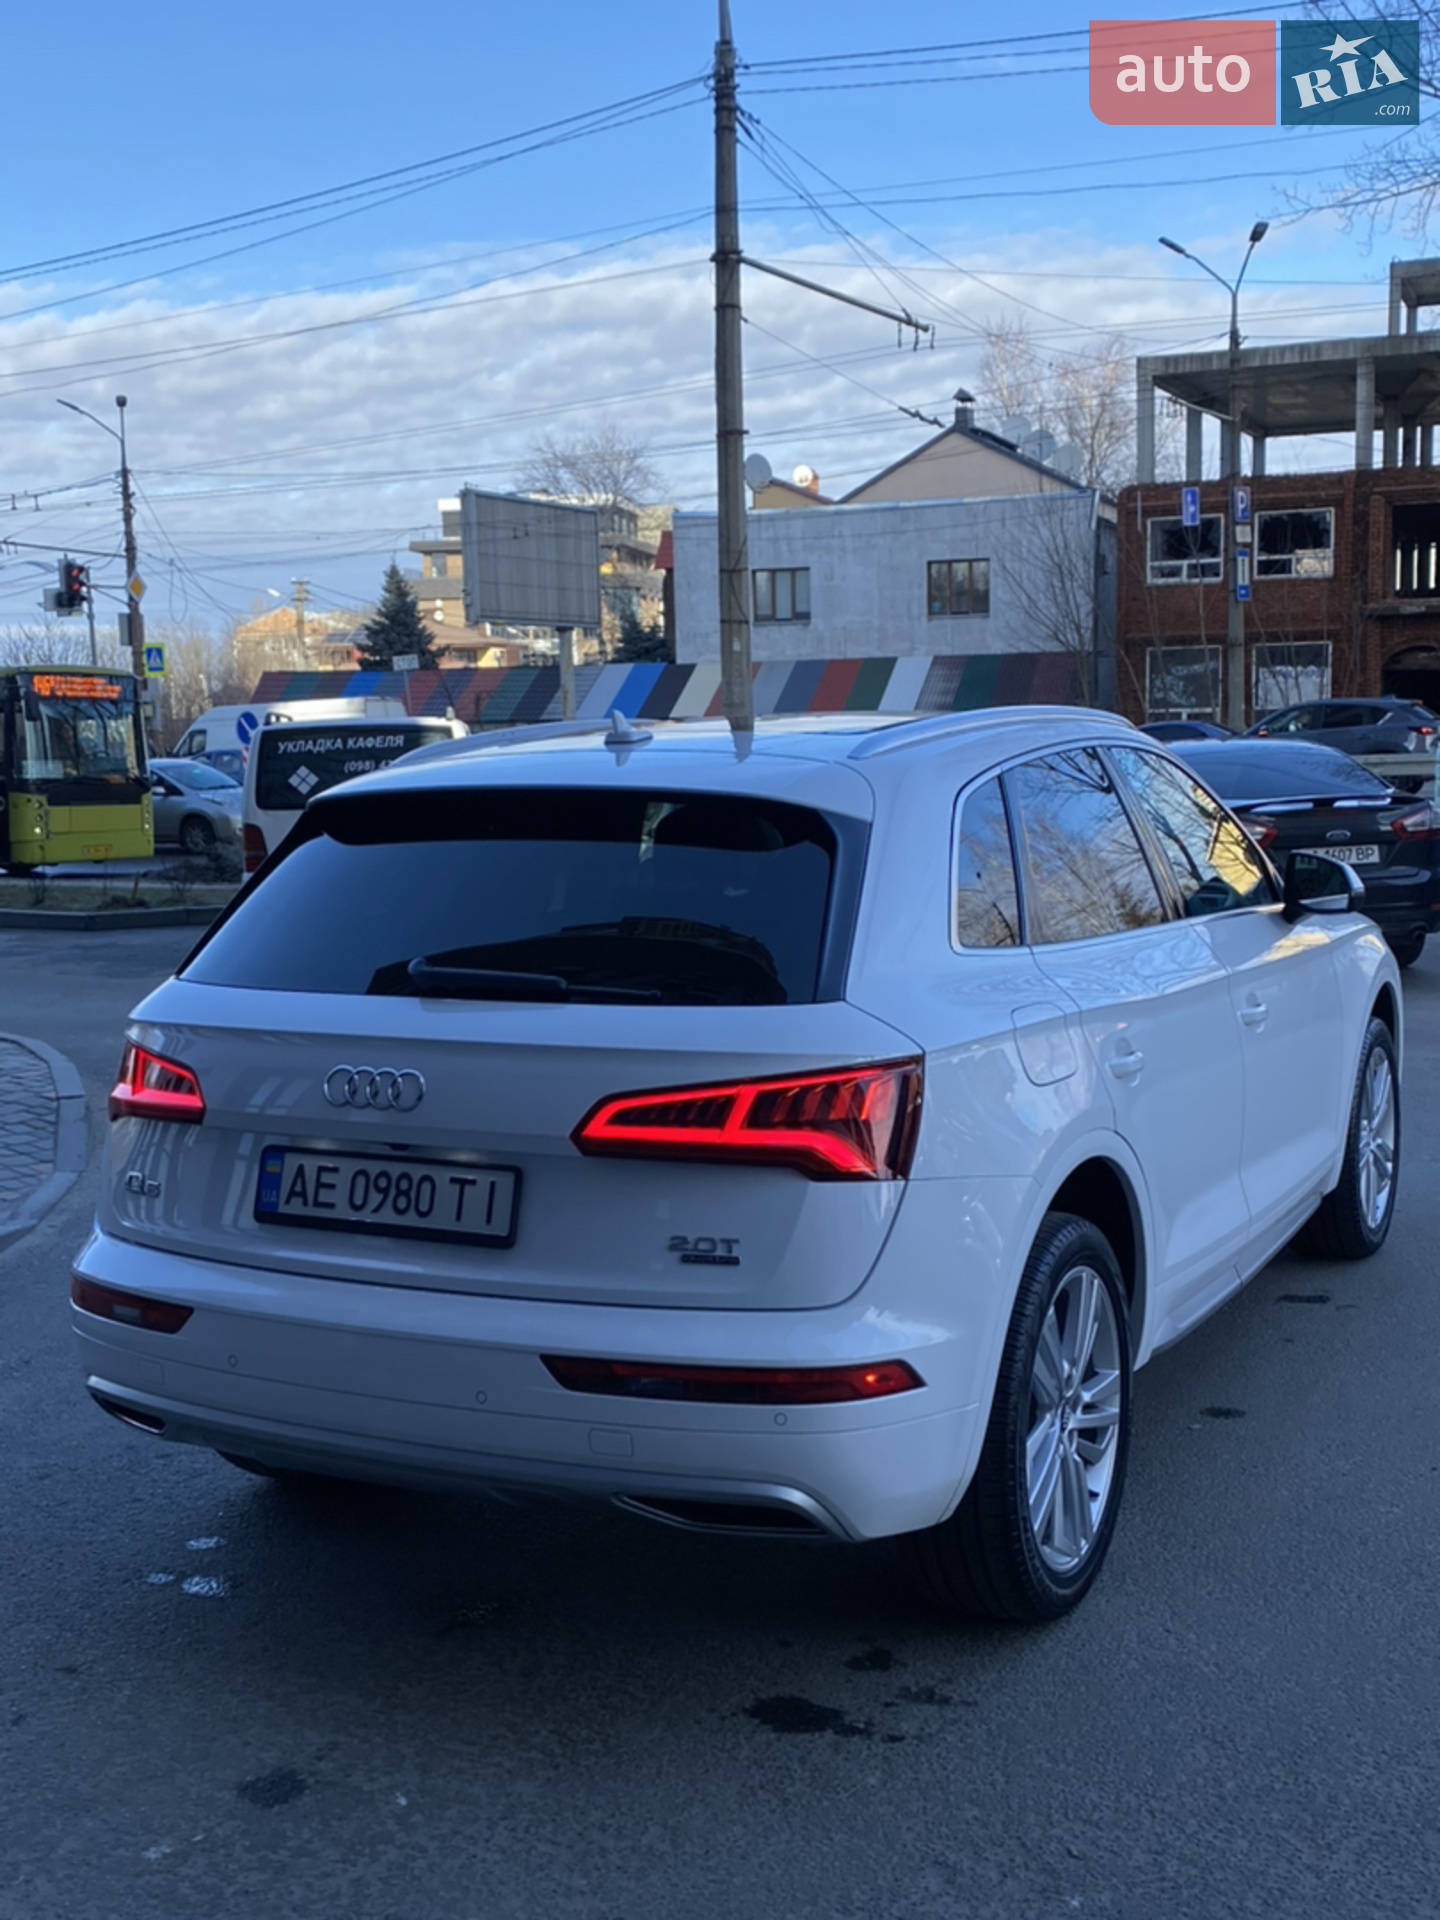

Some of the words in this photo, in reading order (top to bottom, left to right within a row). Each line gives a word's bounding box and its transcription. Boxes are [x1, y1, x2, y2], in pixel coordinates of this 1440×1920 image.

[1238, 490, 1248, 518] P
[278, 738, 344, 755] УКЛАДКА
[346, 735, 405, 750] КАФЕЛЯ
[1355, 847, 1375, 861] BP
[125, 1171, 161, 1199] Q5
[262, 1189, 277, 1203] UA
[284, 1163, 340, 1209] AE
[348, 1168, 436, 1219] 0980
